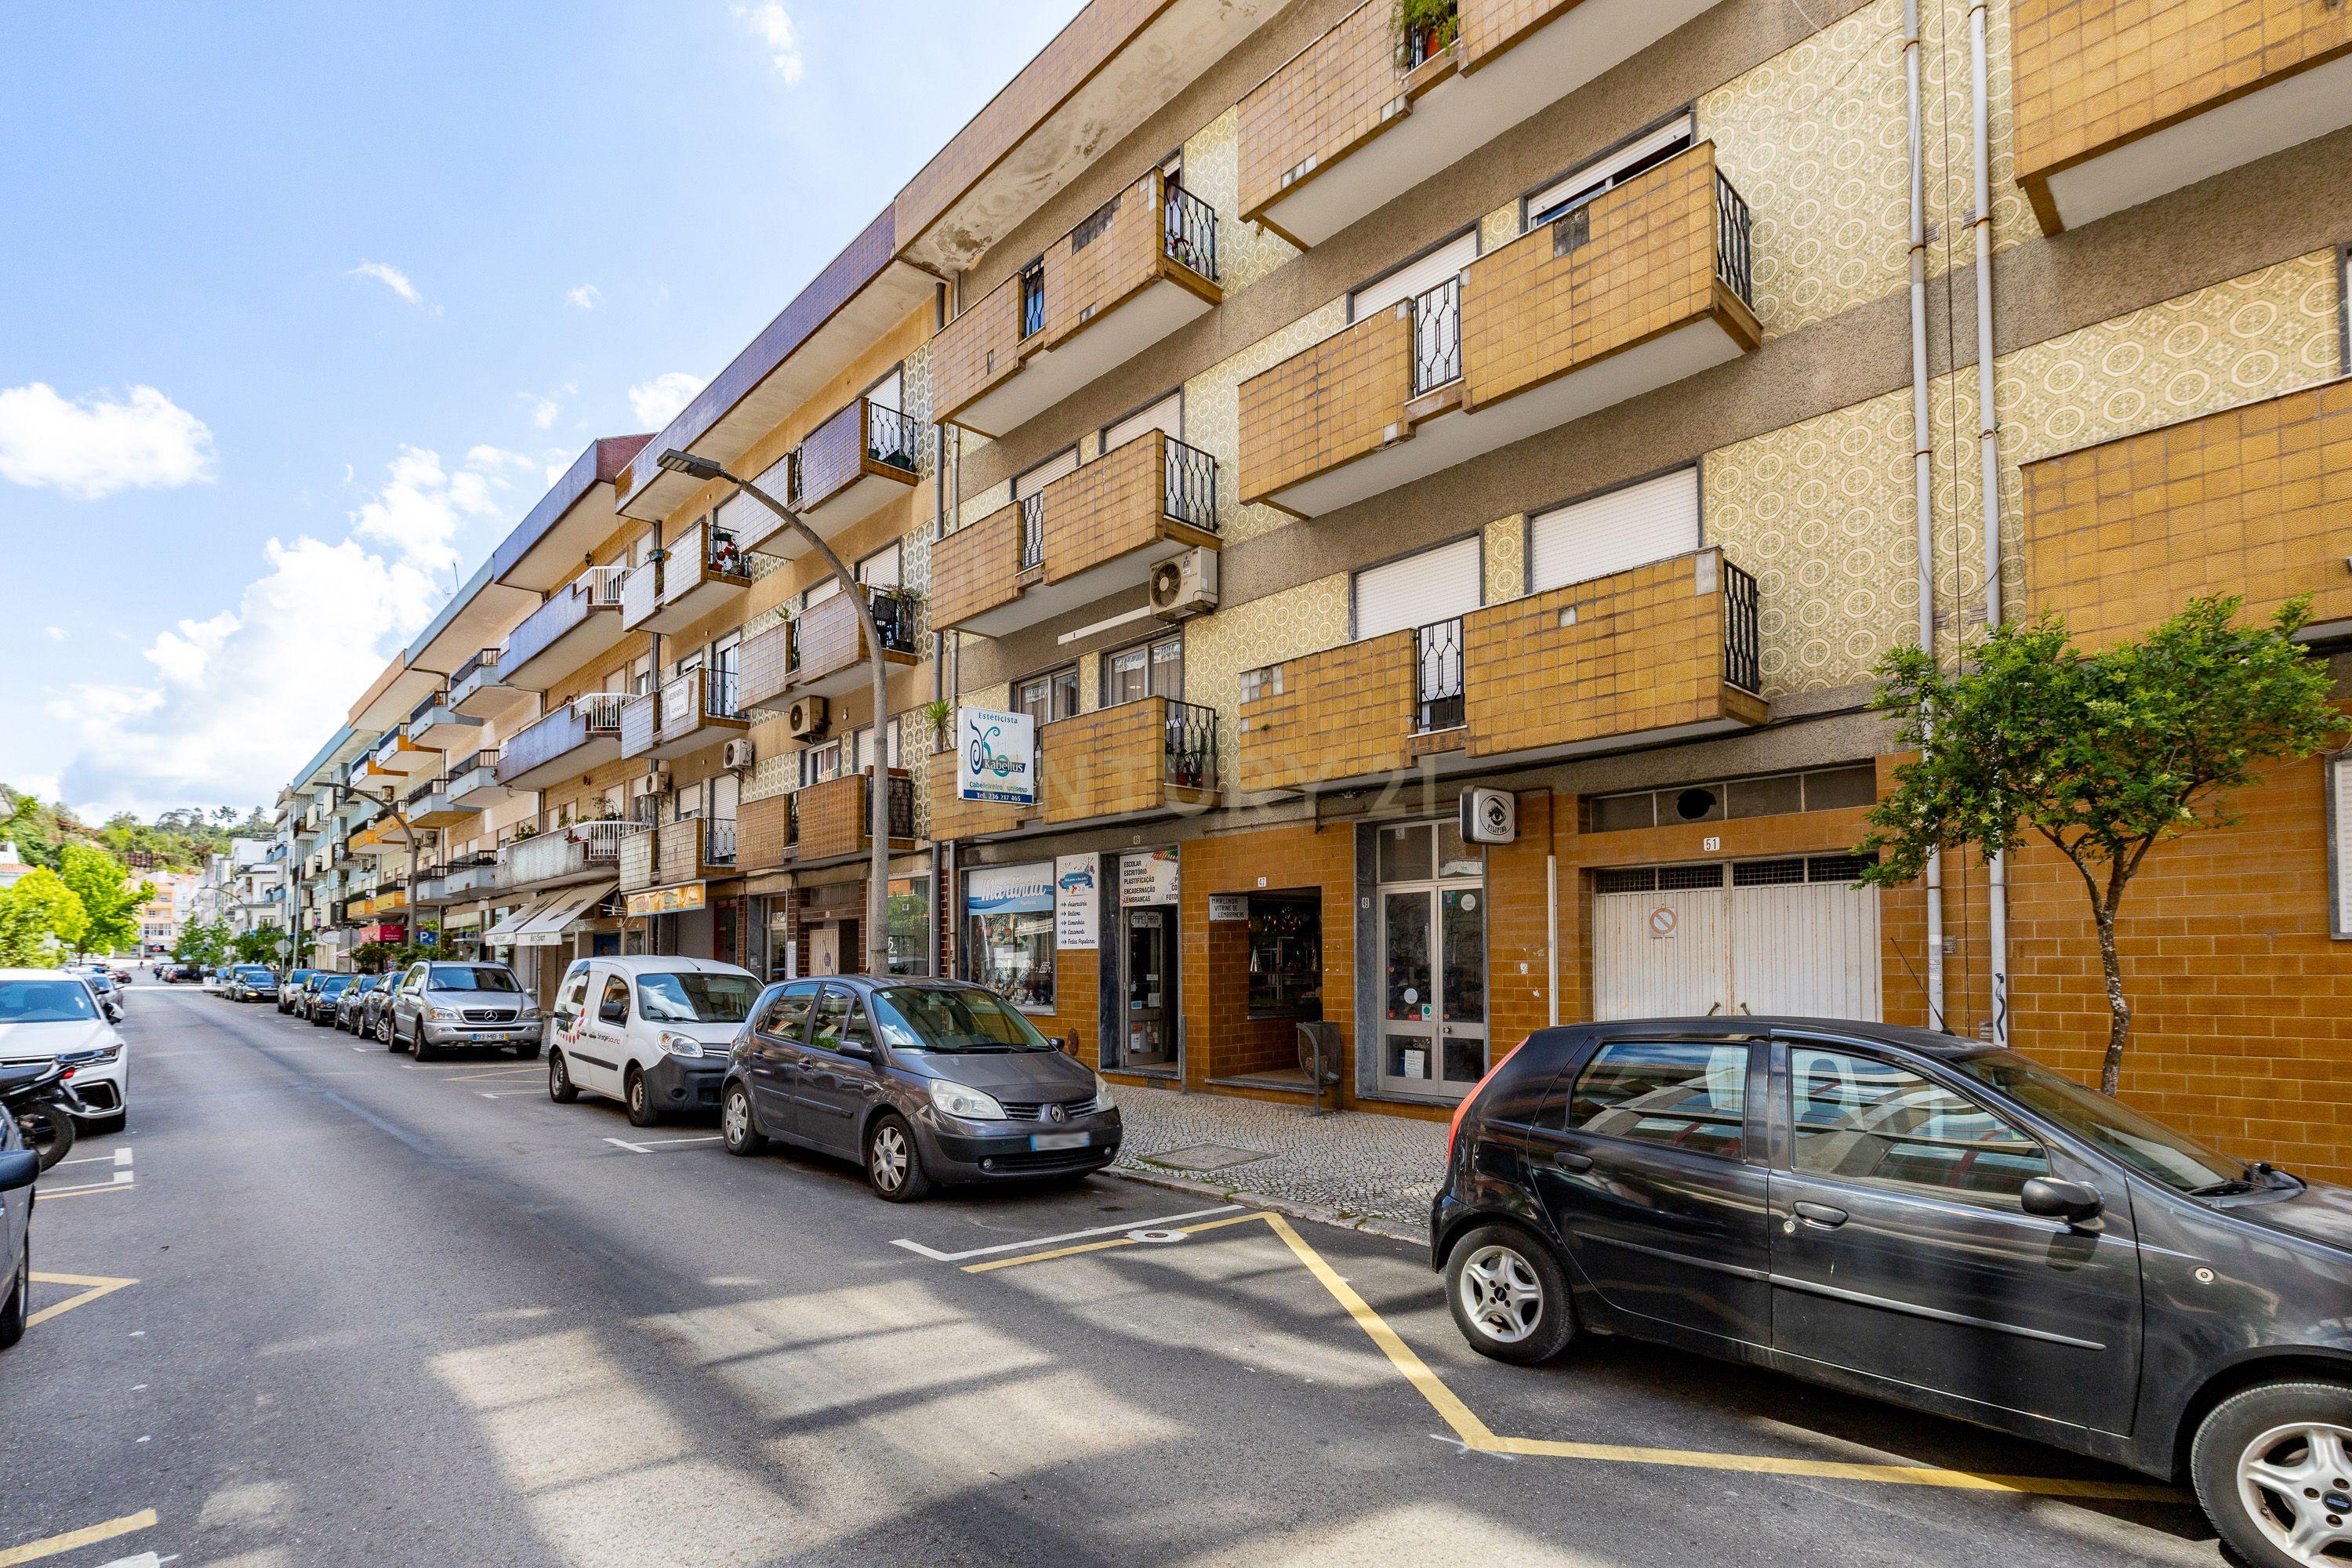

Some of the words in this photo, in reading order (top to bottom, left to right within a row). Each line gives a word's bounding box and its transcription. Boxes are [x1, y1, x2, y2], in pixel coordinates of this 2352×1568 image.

[984, 758, 1024, 772] Kabellus
[1706, 838, 1716, 851] 51
[1123, 868, 1147, 877] ESCRITÓRIO
[1123, 876, 1155, 885] PLASTIFICAÇÃO
[981, 874, 1047, 902] Marlinda
[1123, 885, 1156, 895] ENCADERNAÇÃO
[1363, 898, 1369, 908] 49
[1132, 915, 1159, 924] PAPELARIA
[419, 931, 429, 942] P
